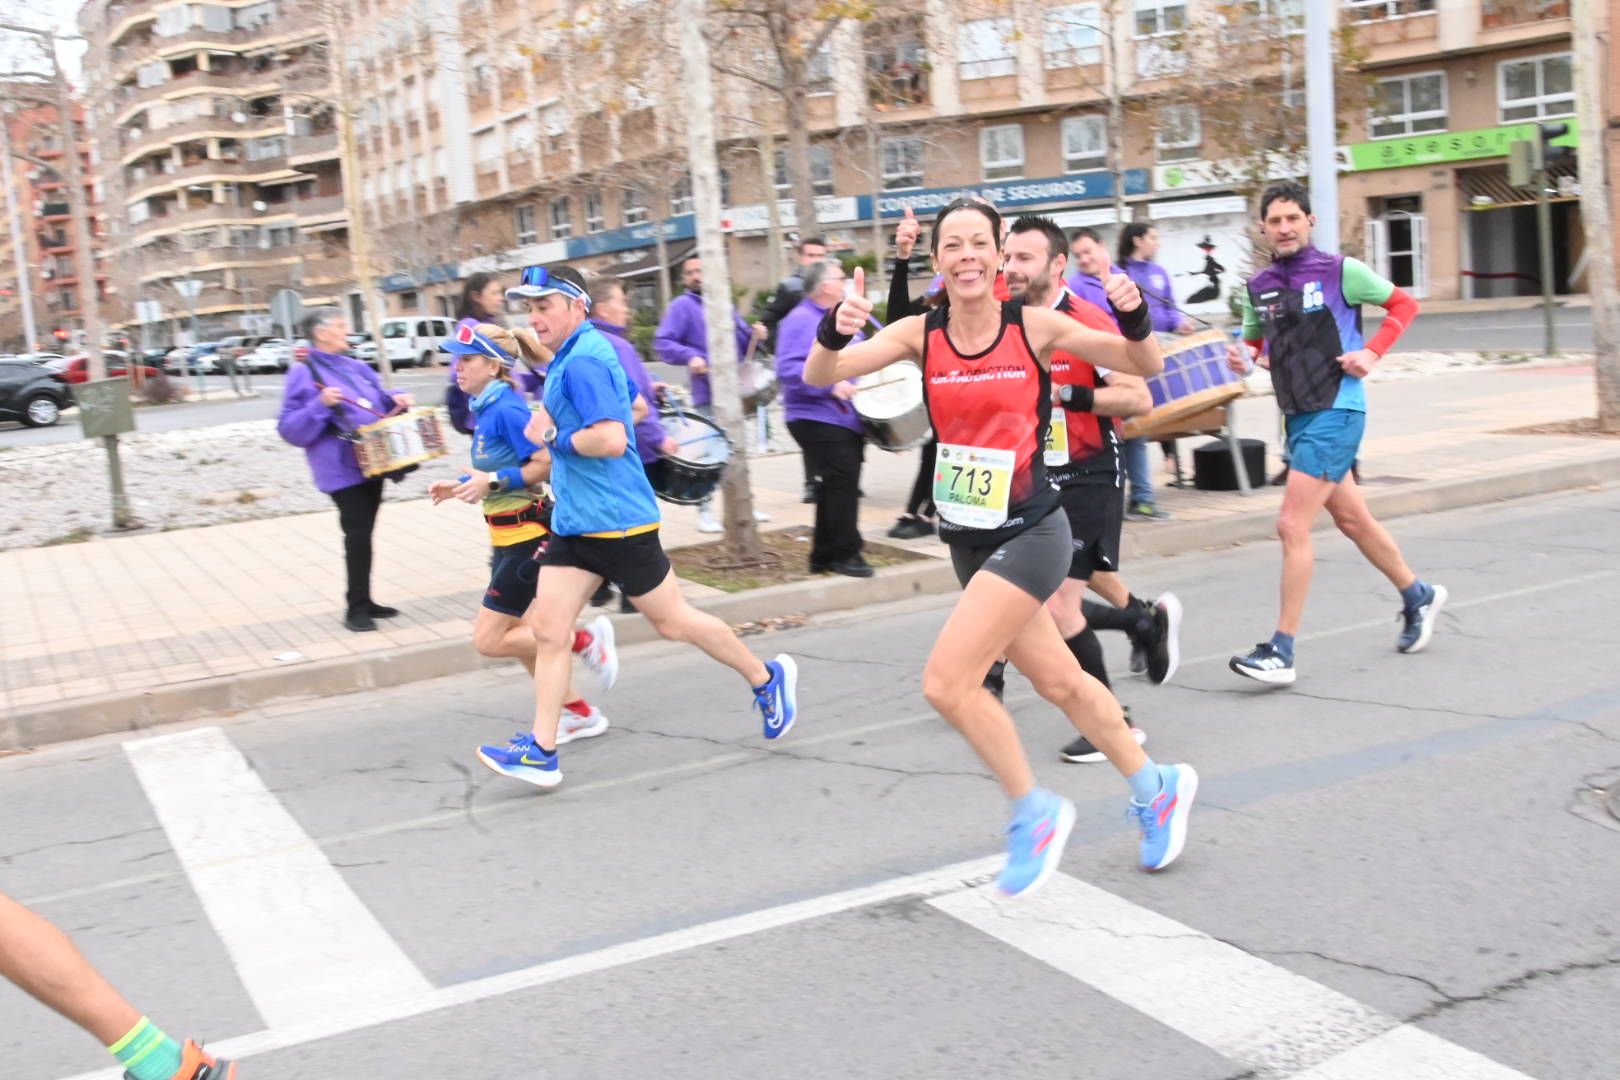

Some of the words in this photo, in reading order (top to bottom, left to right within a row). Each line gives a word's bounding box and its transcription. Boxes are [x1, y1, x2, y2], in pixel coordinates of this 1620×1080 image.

[1007, 179, 1087, 200] SEGUROS
[950, 465, 993, 497] 713
[948, 492, 987, 508] PALOMA
